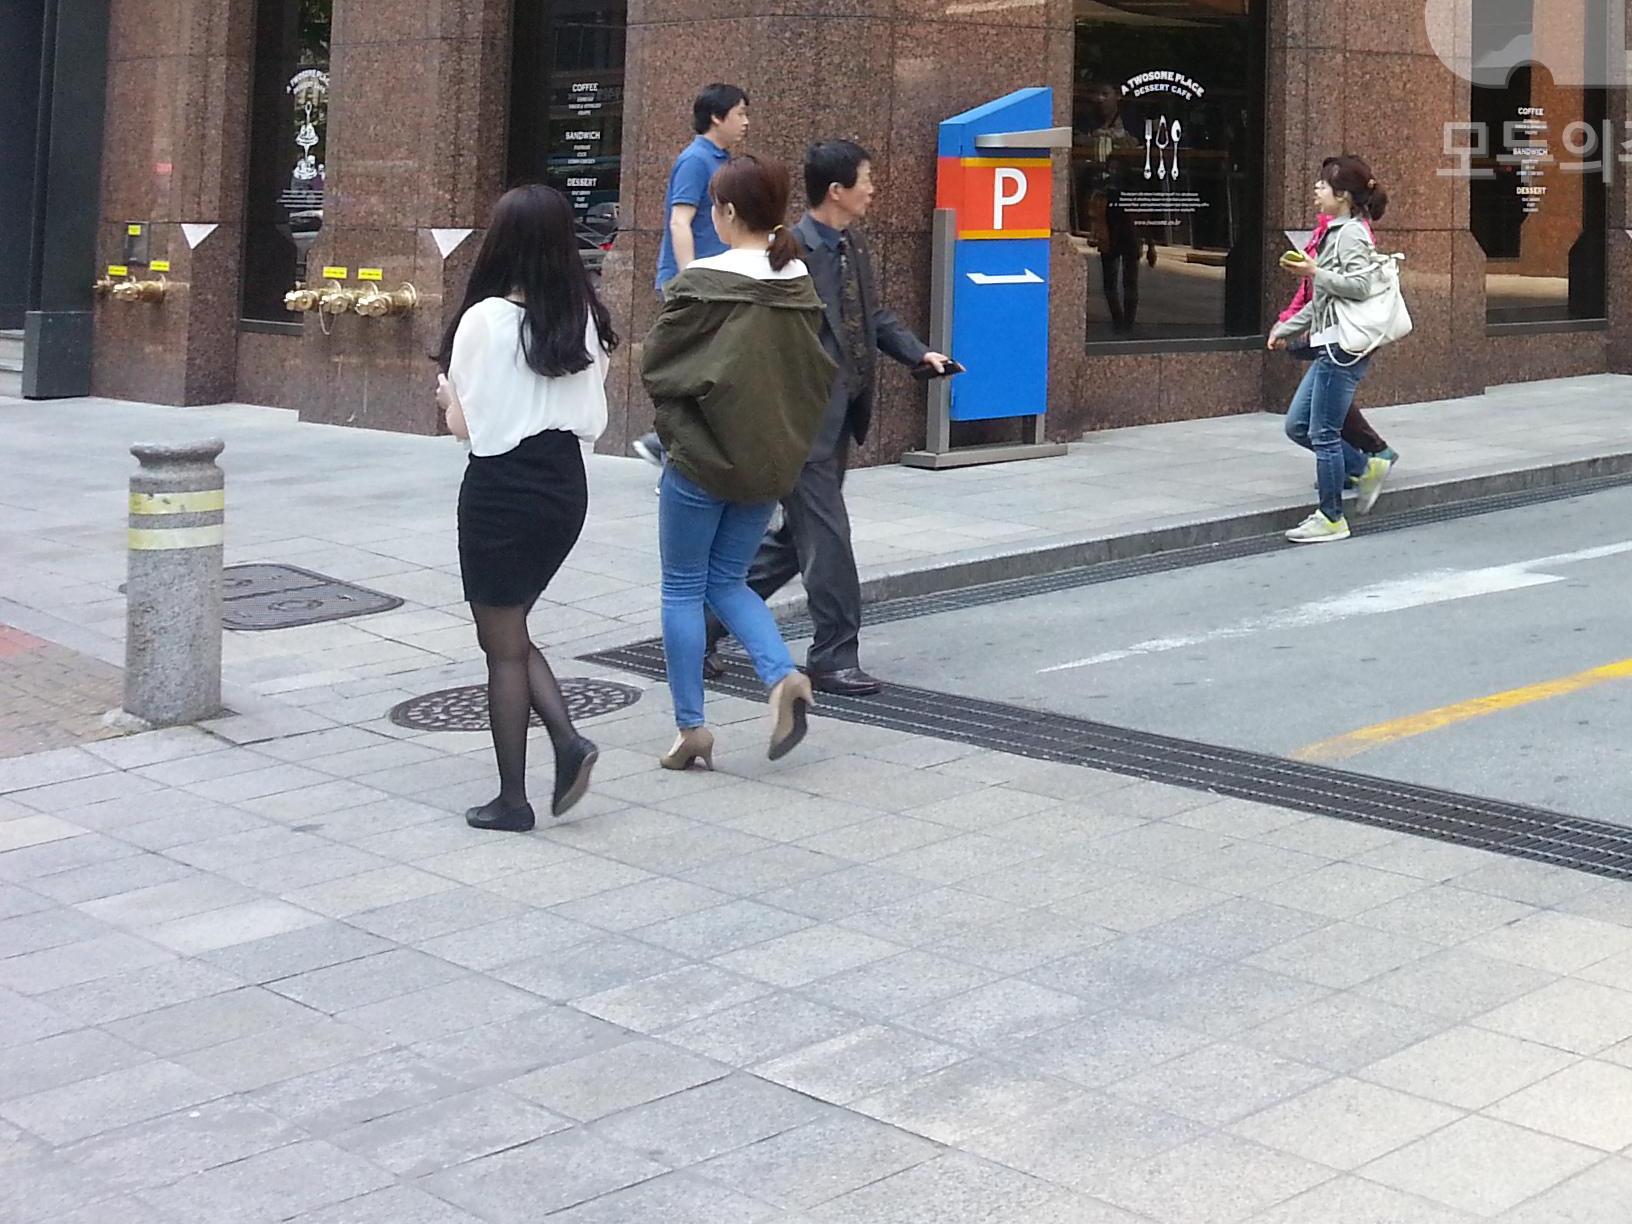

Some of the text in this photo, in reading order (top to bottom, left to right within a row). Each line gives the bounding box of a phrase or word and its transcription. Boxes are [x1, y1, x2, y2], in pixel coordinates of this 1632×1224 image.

[1121, 71, 1205, 97] A TWOSOME PLACE
[1134, 84, 1193, 100] DESSERT CAFE
[1518, 107, 1544, 116] COFFEE
[993, 167, 1028, 230] P
[1516, 186, 1547, 195] DESSERT
